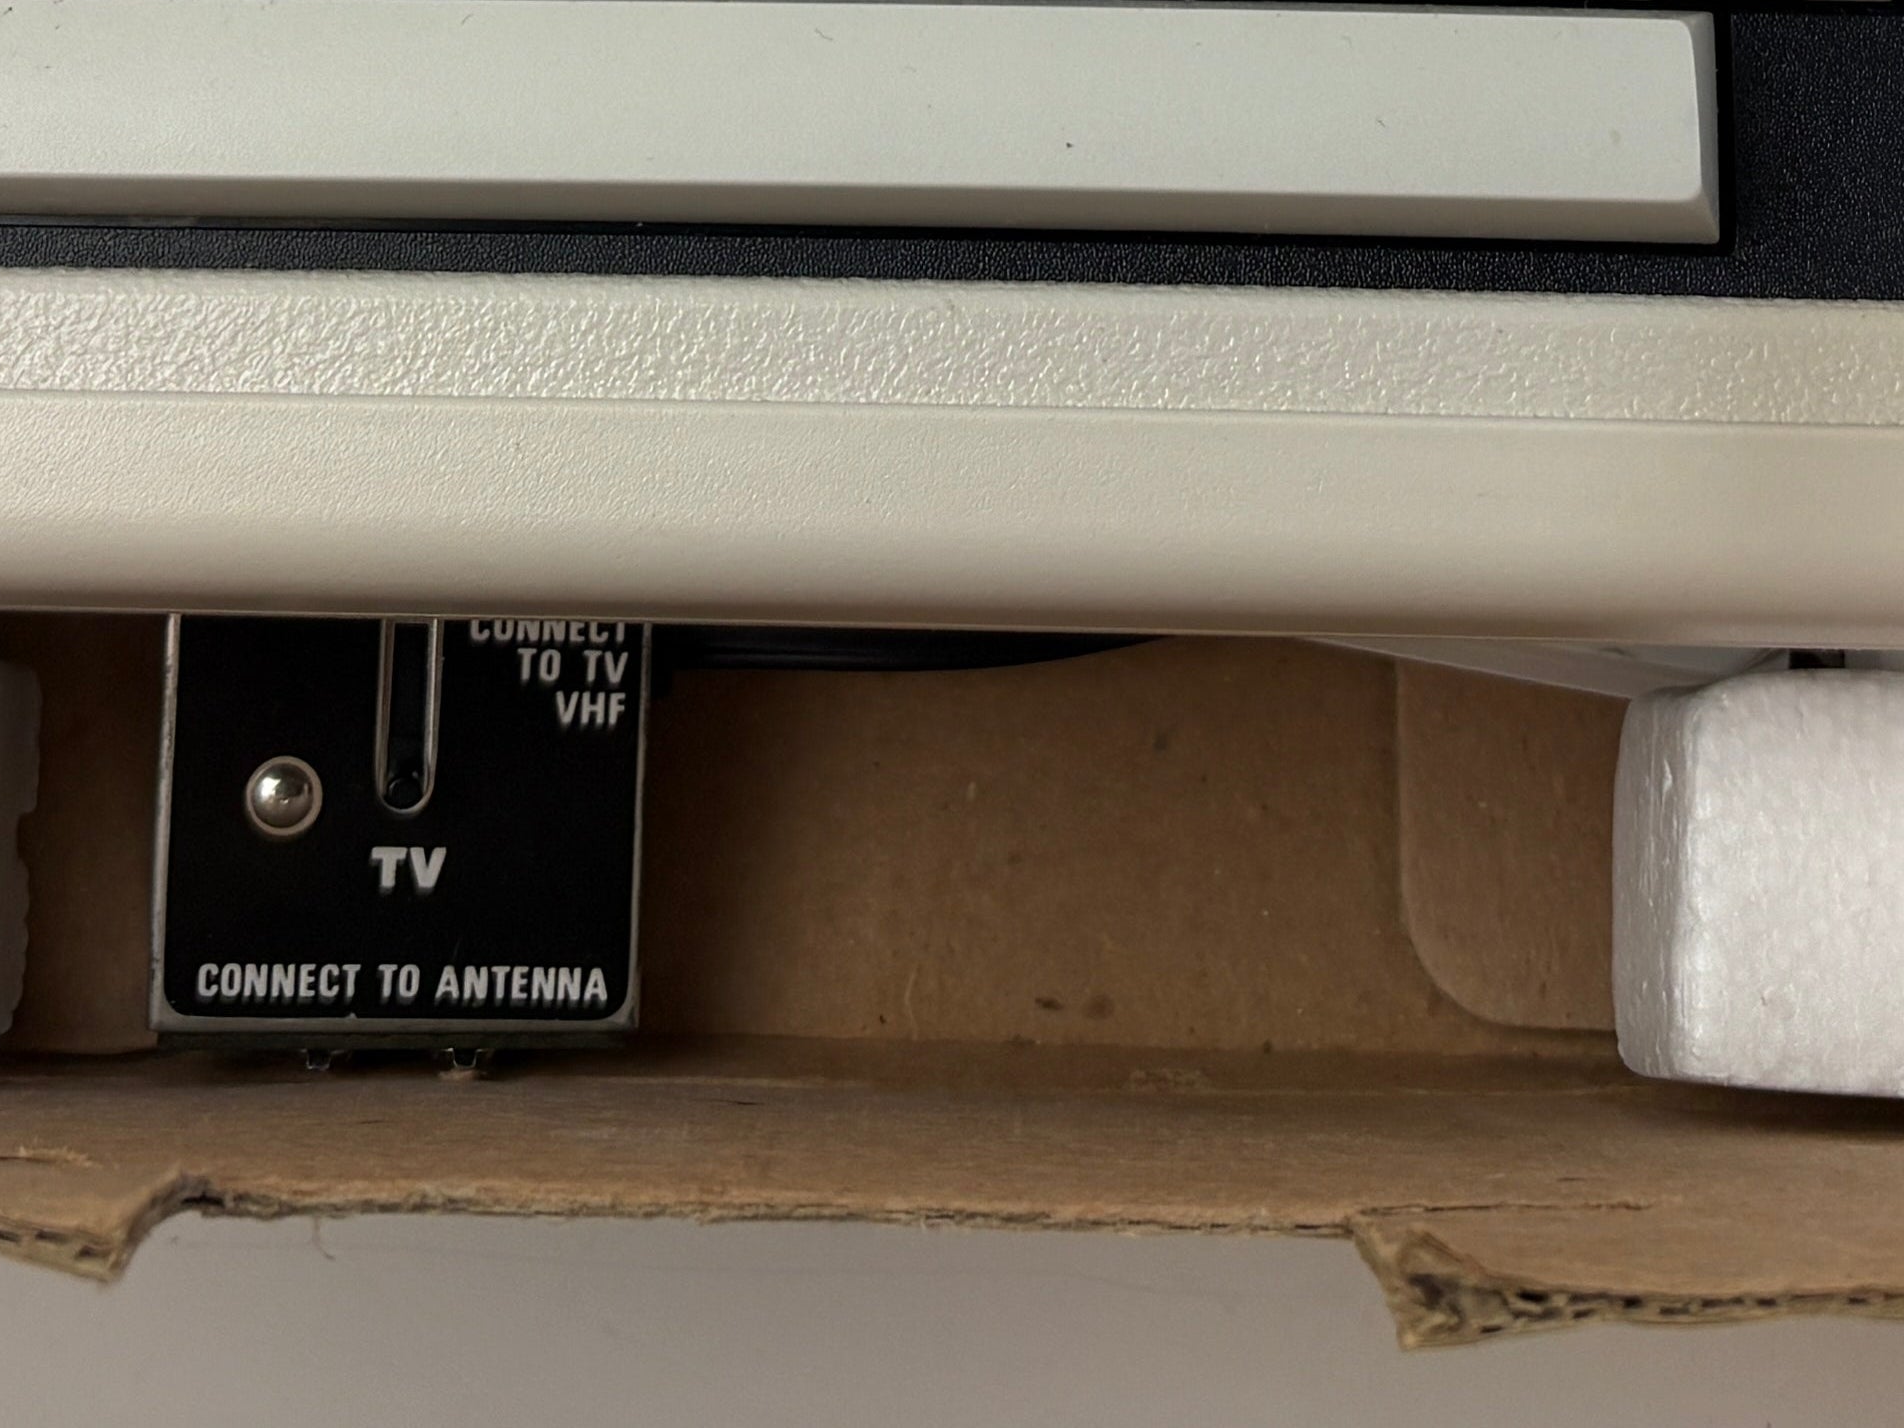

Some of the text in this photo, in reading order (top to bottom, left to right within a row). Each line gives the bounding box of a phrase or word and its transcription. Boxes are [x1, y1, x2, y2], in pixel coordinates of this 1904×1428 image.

[517, 648, 629, 684] TO TV
[554, 691, 626, 726] VHF
[370, 846, 447, 889] TV
[196, 963, 608, 1001] CONNECT TO ANTENNA
